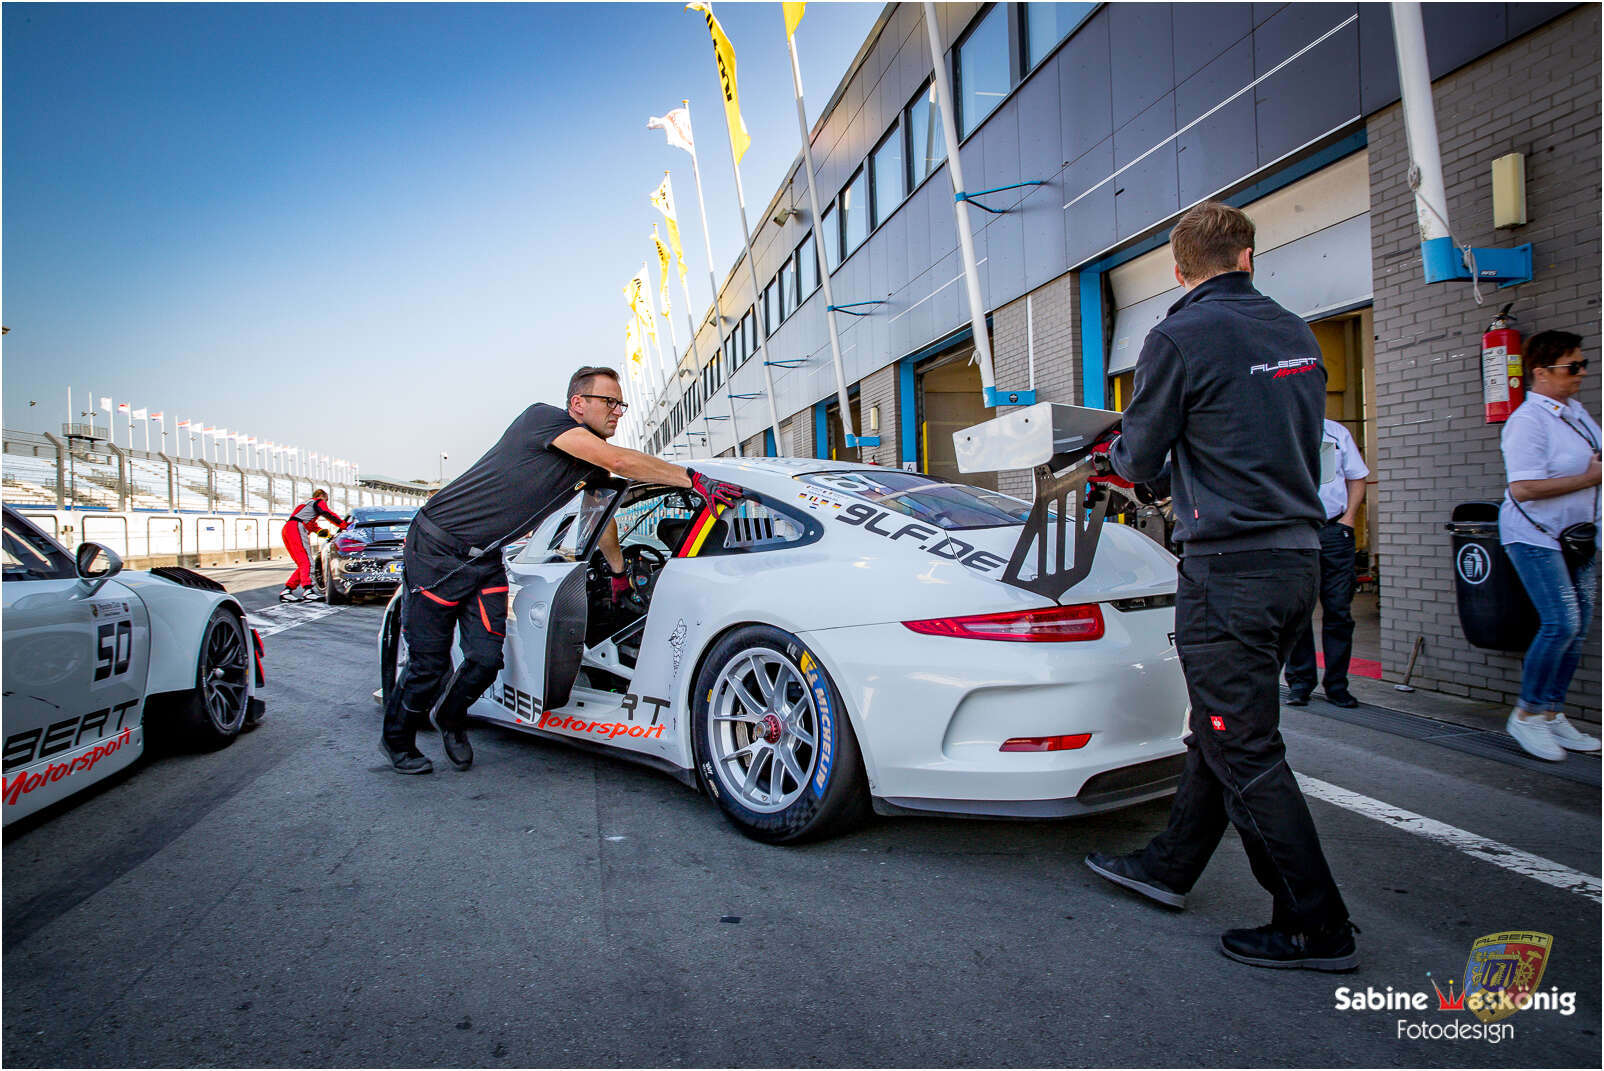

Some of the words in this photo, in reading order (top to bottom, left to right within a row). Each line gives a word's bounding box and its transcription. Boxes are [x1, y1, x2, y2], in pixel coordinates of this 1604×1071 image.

[1250, 357, 1317, 375] ALBERT
[835, 503, 1009, 572] 9LF.DE
[94, 620, 132, 681] 50
[2, 727, 131, 805] Motorsport
[815, 688, 832, 788] MICHELIN
